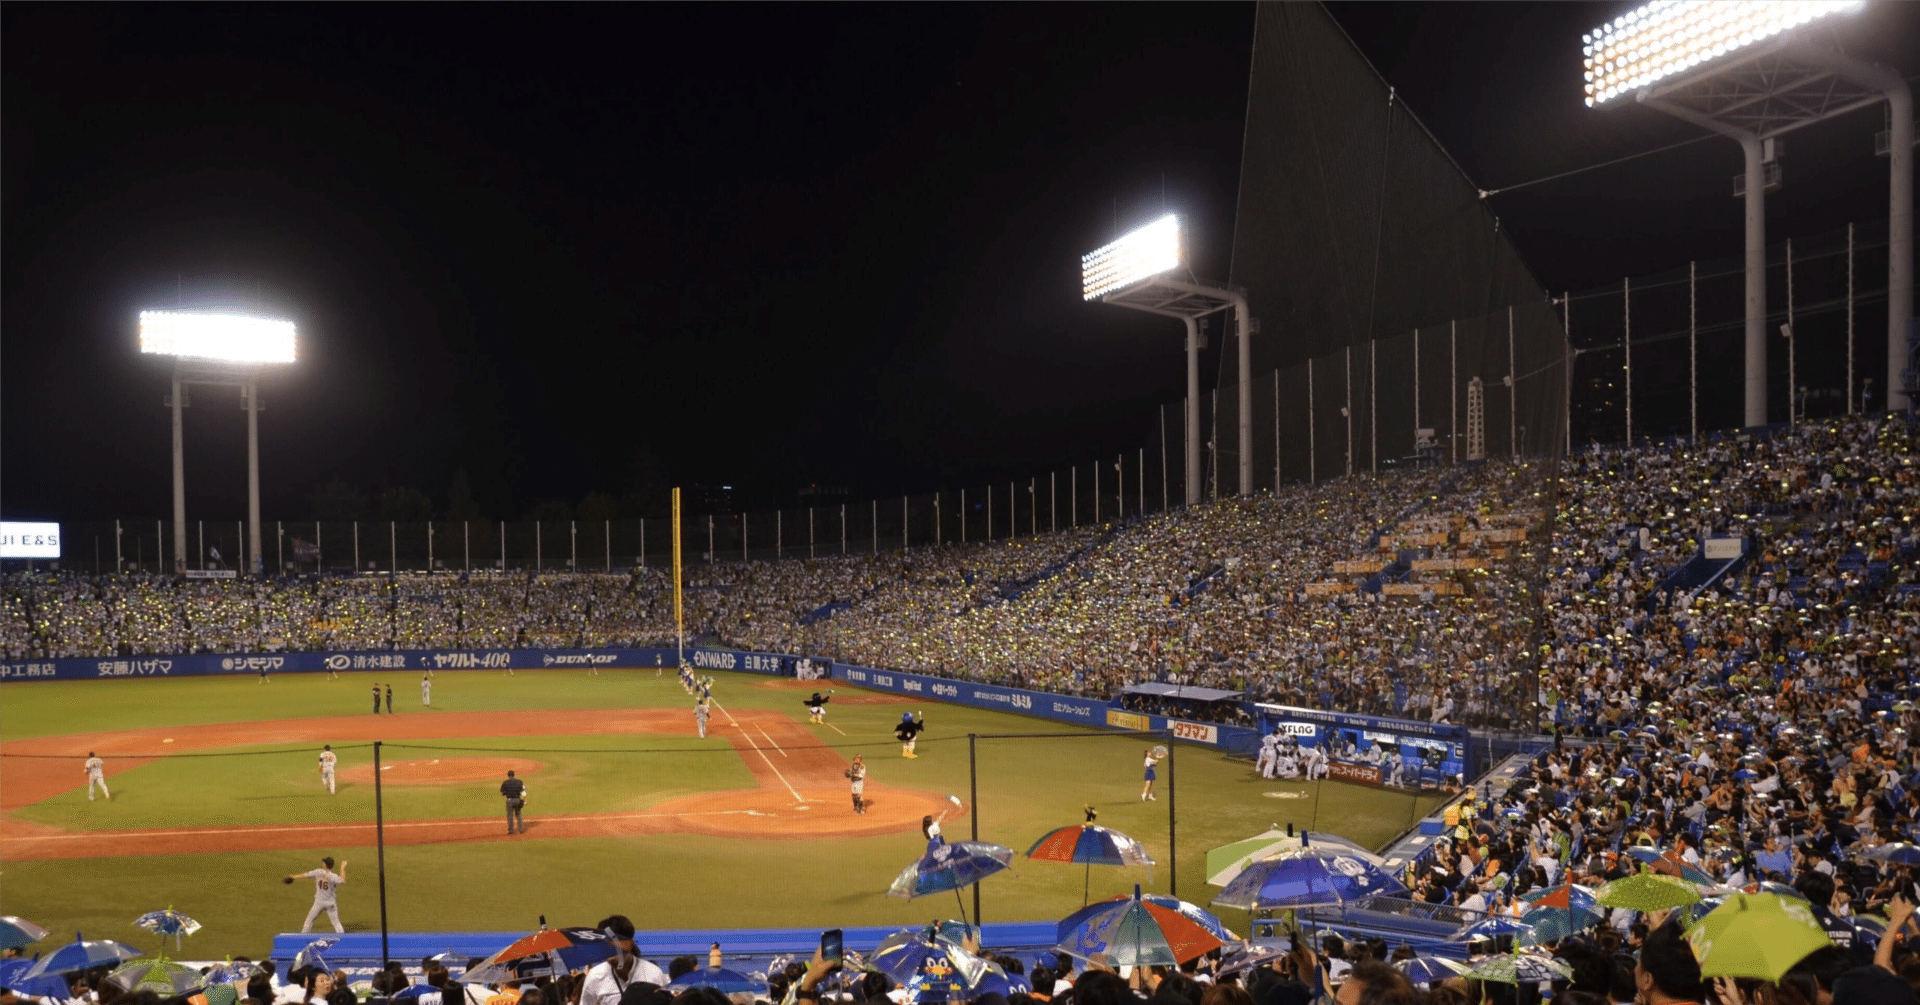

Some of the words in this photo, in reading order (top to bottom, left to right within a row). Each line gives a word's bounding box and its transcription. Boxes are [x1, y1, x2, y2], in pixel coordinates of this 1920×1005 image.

[22, 535, 57, 546] E&S
[97, 659, 173, 676] 安藤ハザマ
[354, 655, 406, 668] 清水建設
[694, 651, 736, 669] ONWARD
